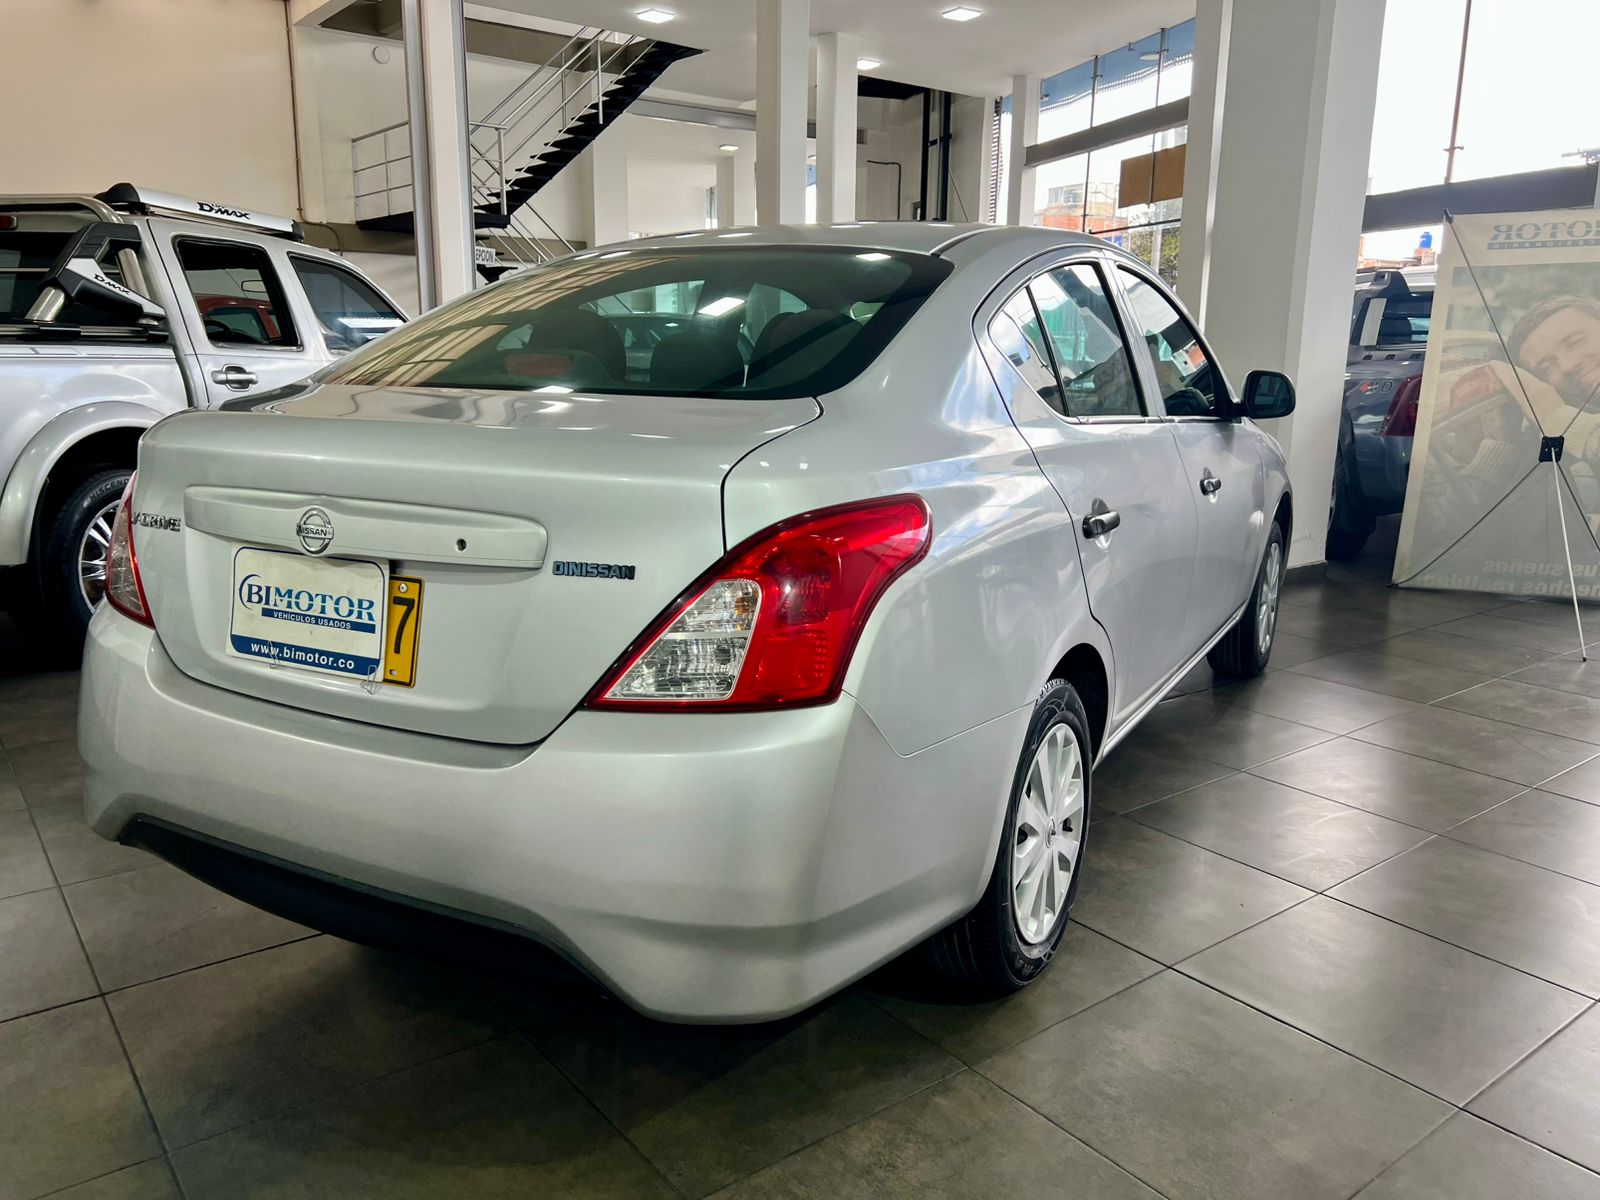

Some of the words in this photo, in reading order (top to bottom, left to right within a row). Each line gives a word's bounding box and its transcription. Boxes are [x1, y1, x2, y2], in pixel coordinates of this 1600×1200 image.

[475, 248, 495, 263] EPCION
[297, 525, 329, 537] NISSAN
[552, 560, 636, 580] DINISSAN
[245, 583, 376, 622] BIMOTOR
[318, 618, 352, 630] USADOS
[392, 596, 416, 655] 7
[251, 641, 355, 670] www.bimotor.co
